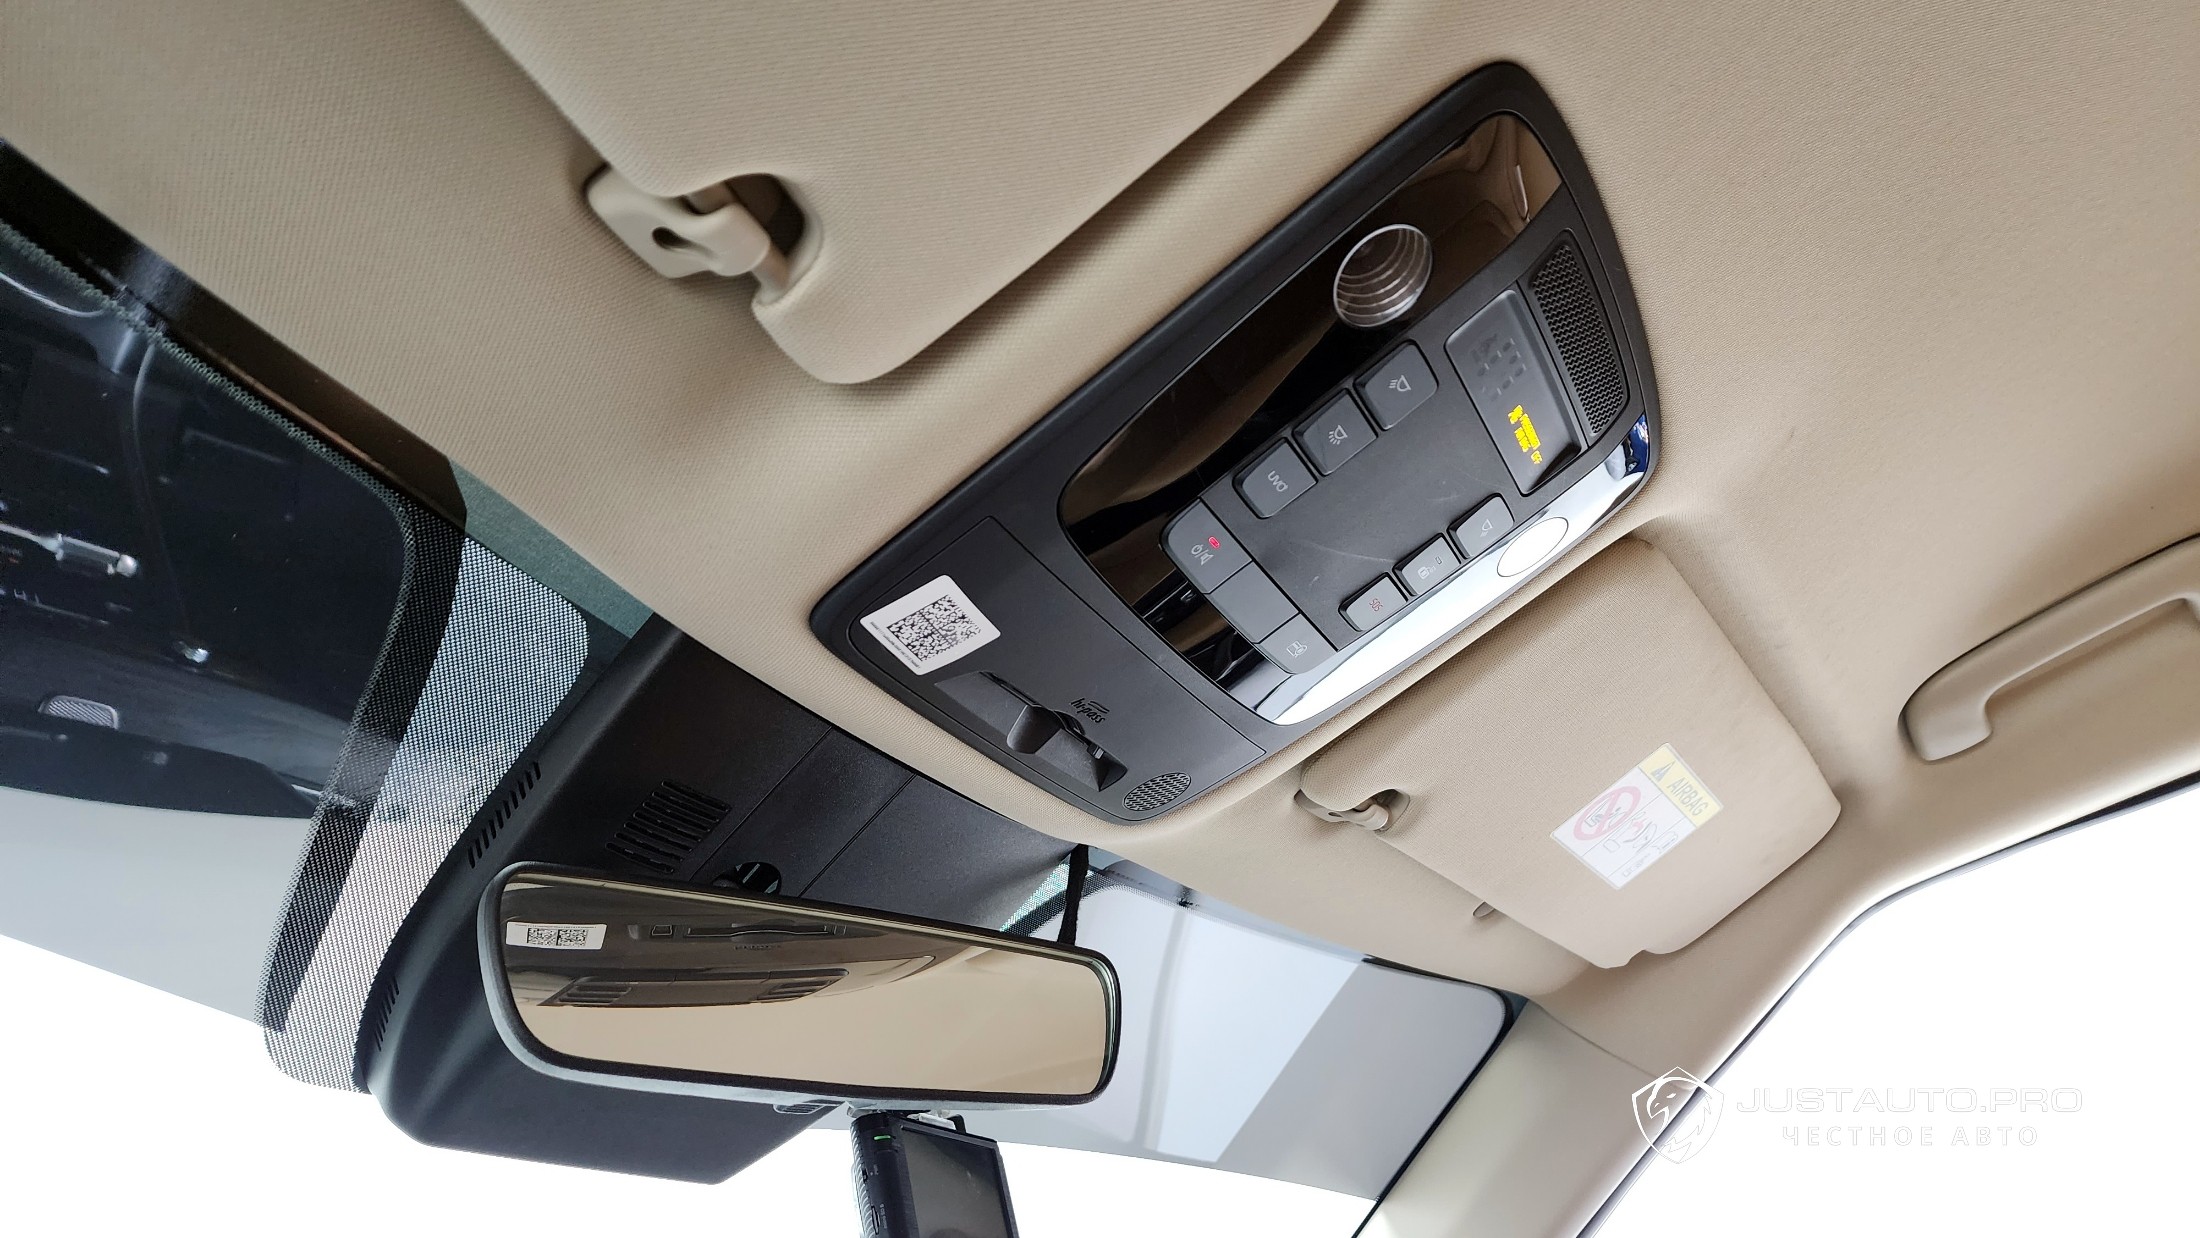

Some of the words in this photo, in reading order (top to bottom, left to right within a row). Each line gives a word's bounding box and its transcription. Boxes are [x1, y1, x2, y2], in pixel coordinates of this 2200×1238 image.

[1267, 470, 1289, 492] UVO
[1368, 598, 1383, 612] SOS
[1666, 776, 1709, 816] AIRBAG
